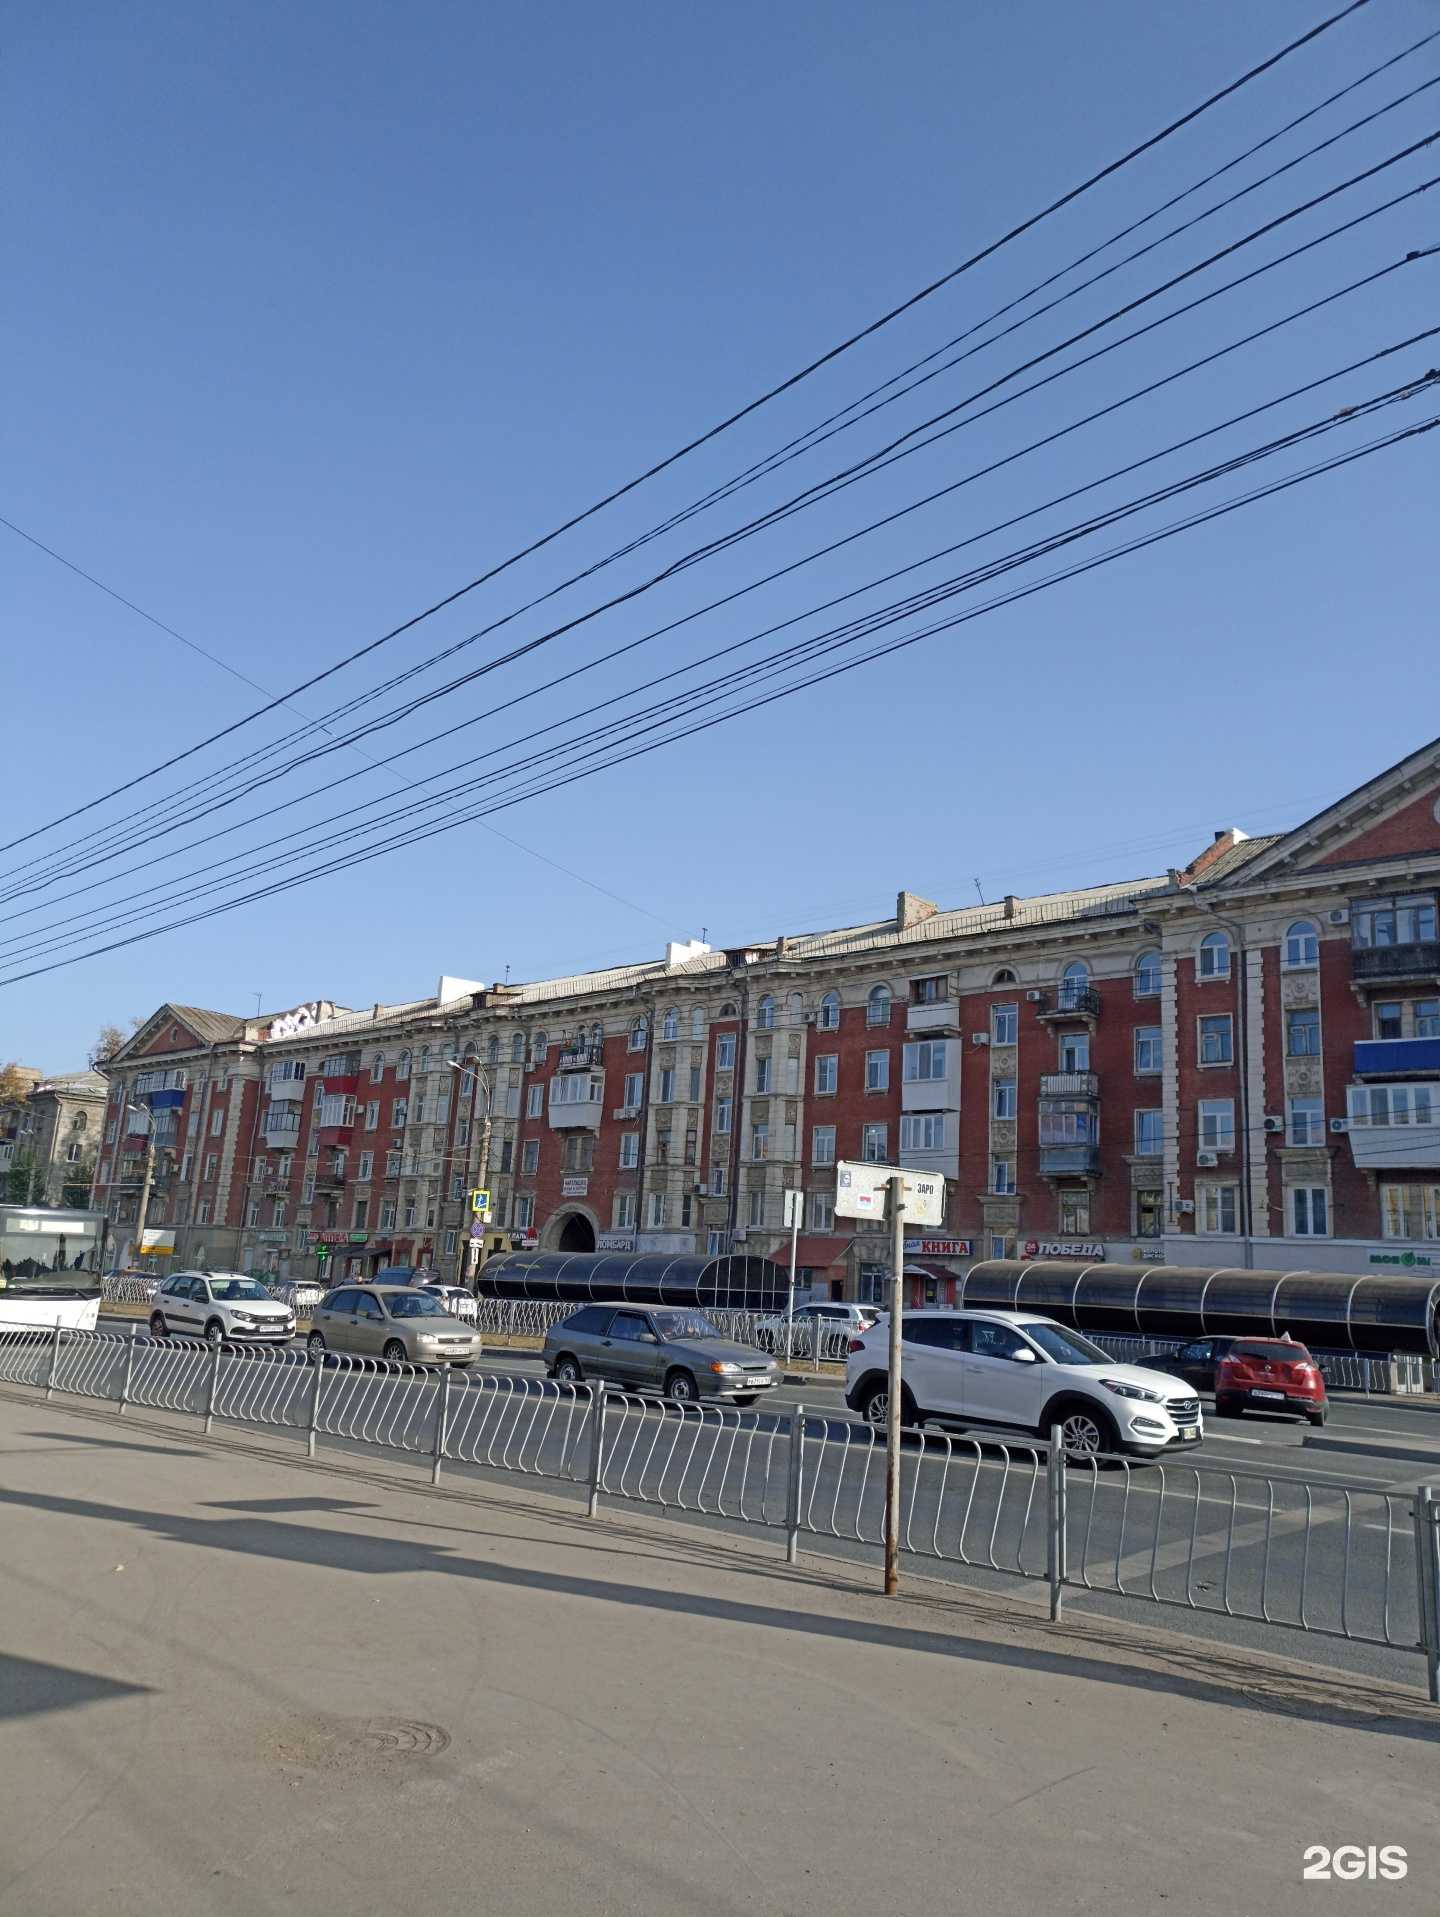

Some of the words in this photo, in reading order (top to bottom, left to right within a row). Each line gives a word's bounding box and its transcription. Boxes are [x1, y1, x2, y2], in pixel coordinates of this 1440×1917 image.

[597, 1239, 631, 1251] ЛОМБАРД
[921, 1240, 969, 1253] КНИГА
[1039, 1243, 1105, 1256] ПОБЕДА
